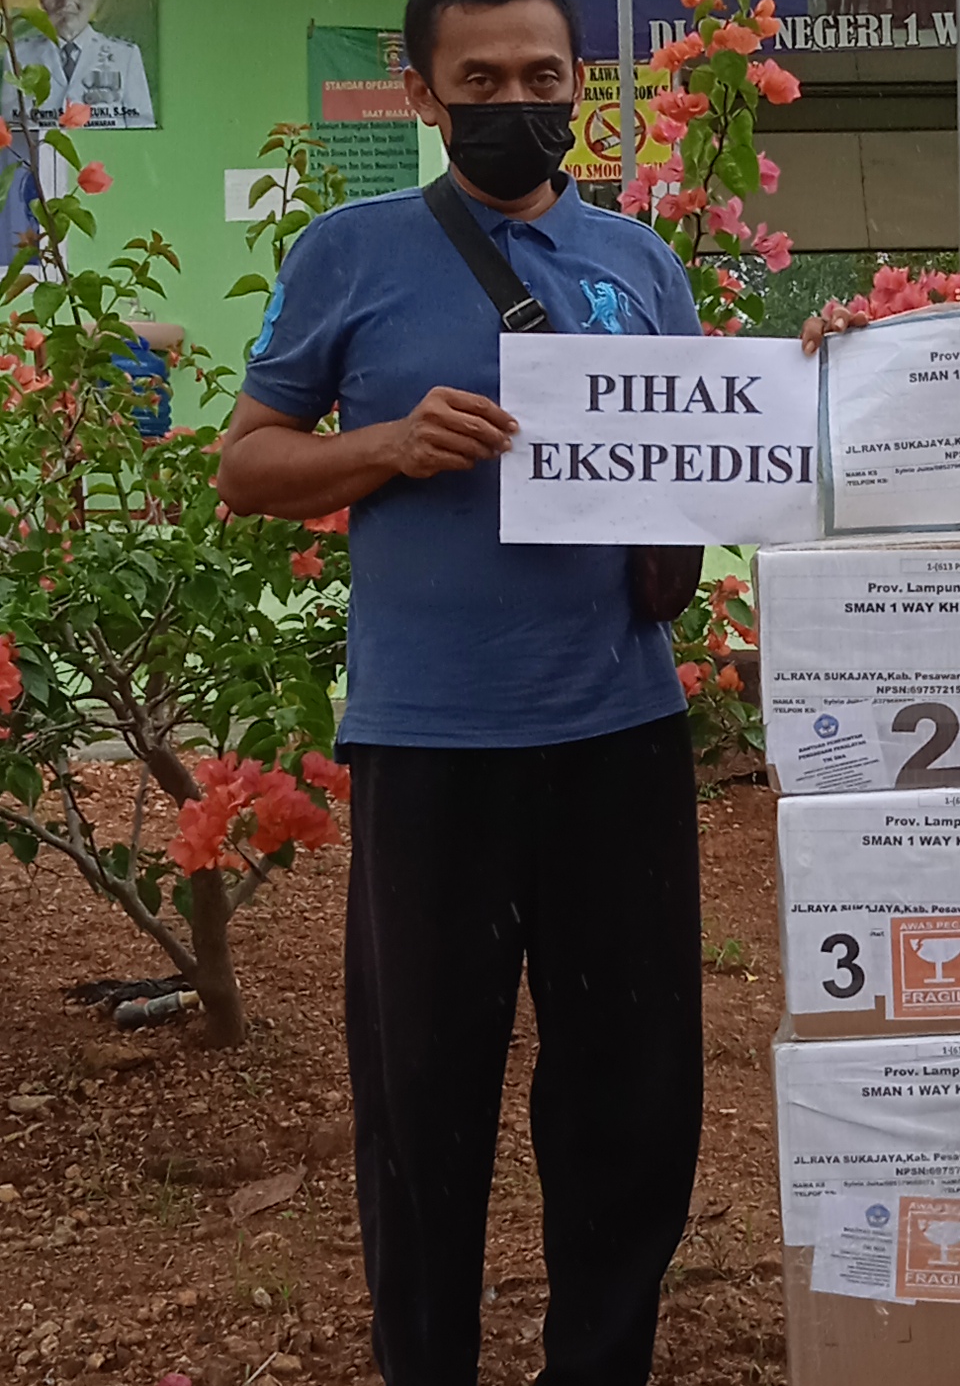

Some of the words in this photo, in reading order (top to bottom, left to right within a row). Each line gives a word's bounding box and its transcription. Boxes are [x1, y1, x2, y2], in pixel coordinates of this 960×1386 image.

[774, 13, 893, 50] NEGERI
[903, 13, 920, 46] 1
[590, 67, 638, 81] KAWAN
[909, 370, 949, 383] SMAN
[953, 369, 960, 381] 1
[585, 374, 763, 415] PIHAK
[528, 442, 814, 484] EKSPEDISI
[868, 582, 903, 594] Prov.
[844, 602, 885, 613] SMAN
[890, 602, 897, 613] 1
[902, 602, 934, 613] WAY
[885, 816, 920, 827] Prov.
[862, 835, 903, 847] SMAN
[907, 835, 914, 847] 1
[919, 835, 952, 847] WAY
[900, 922, 933, 931] AWAS
[820, 933, 865, 999] 3
[884, 1066, 918, 1077] Prov.
[861, 1086, 902, 1098] SMAN
[907, 1085, 914, 1096] 1
[919, 1085, 951, 1096] WAY
